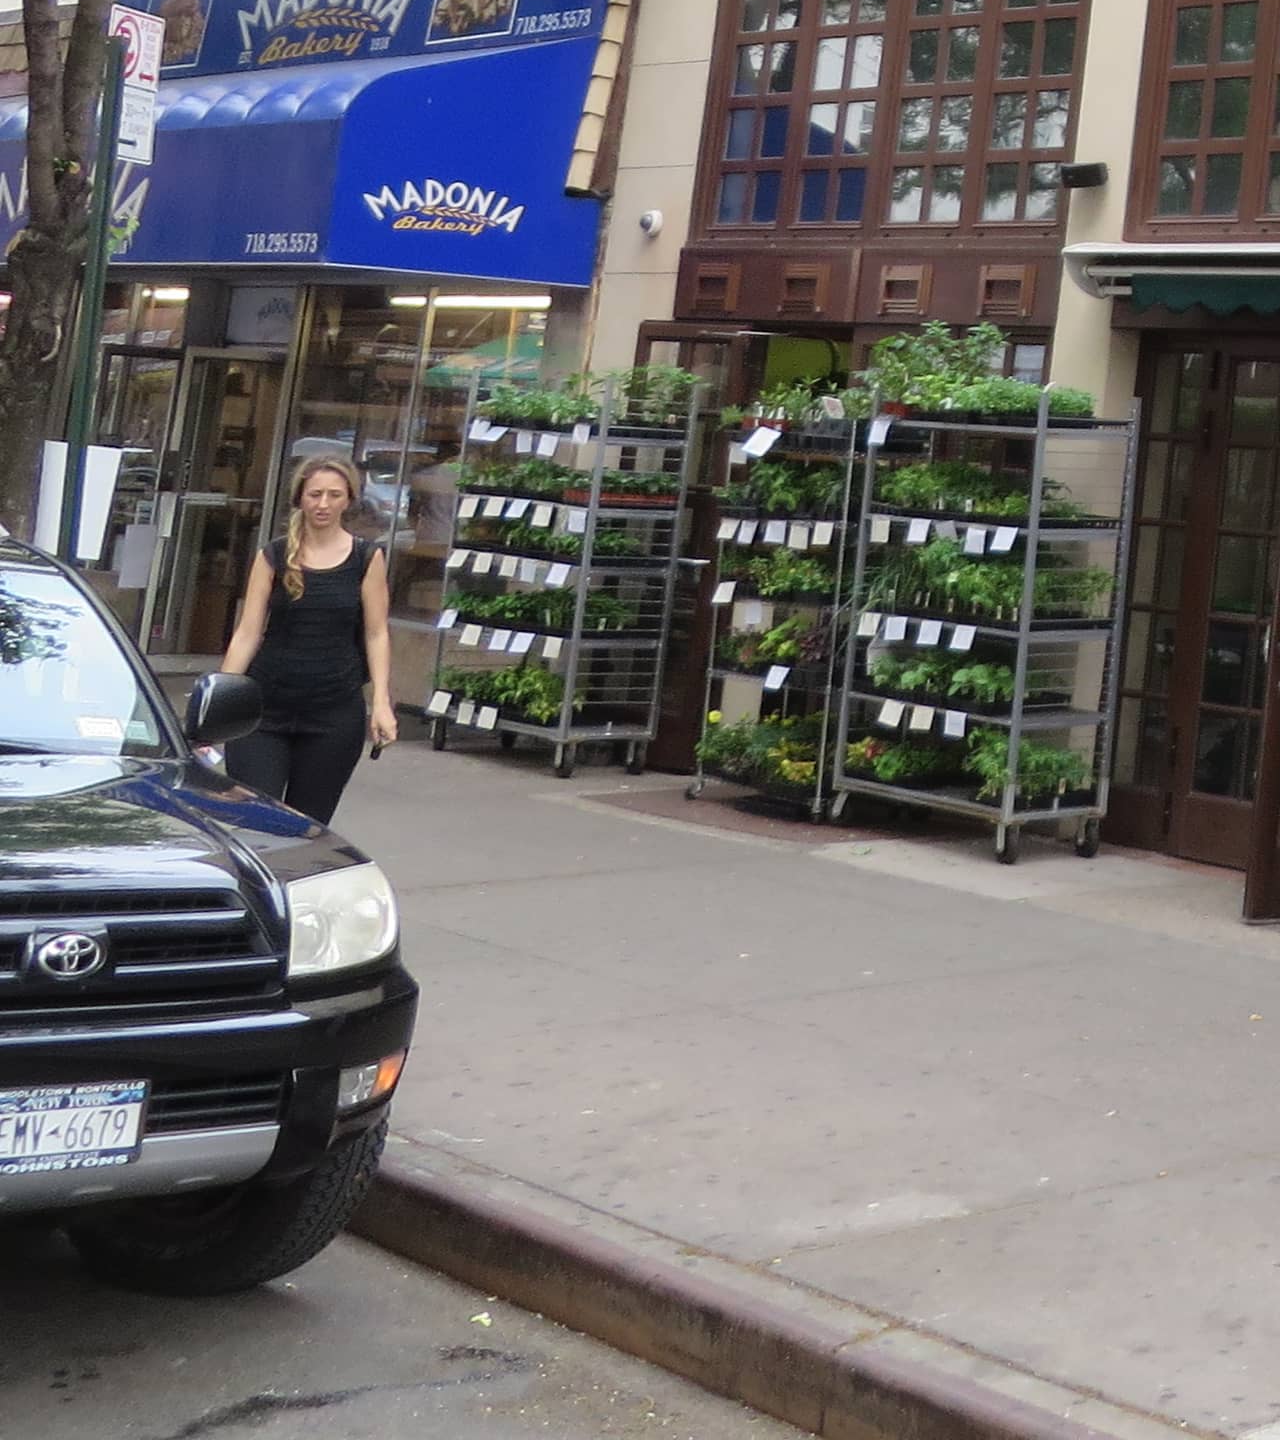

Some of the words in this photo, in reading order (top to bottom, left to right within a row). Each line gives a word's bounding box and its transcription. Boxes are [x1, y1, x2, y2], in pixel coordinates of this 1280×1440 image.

[512, 7, 592, 37] 718.295.5573
[258, 30, 365, 65] Bakery
[363, 178, 526, 233] MADONIA
[392, 215, 485, 236] Bakery
[244, 232, 319, 254] 718.295.5573
[64, 1108, 128, 1149] 6679
